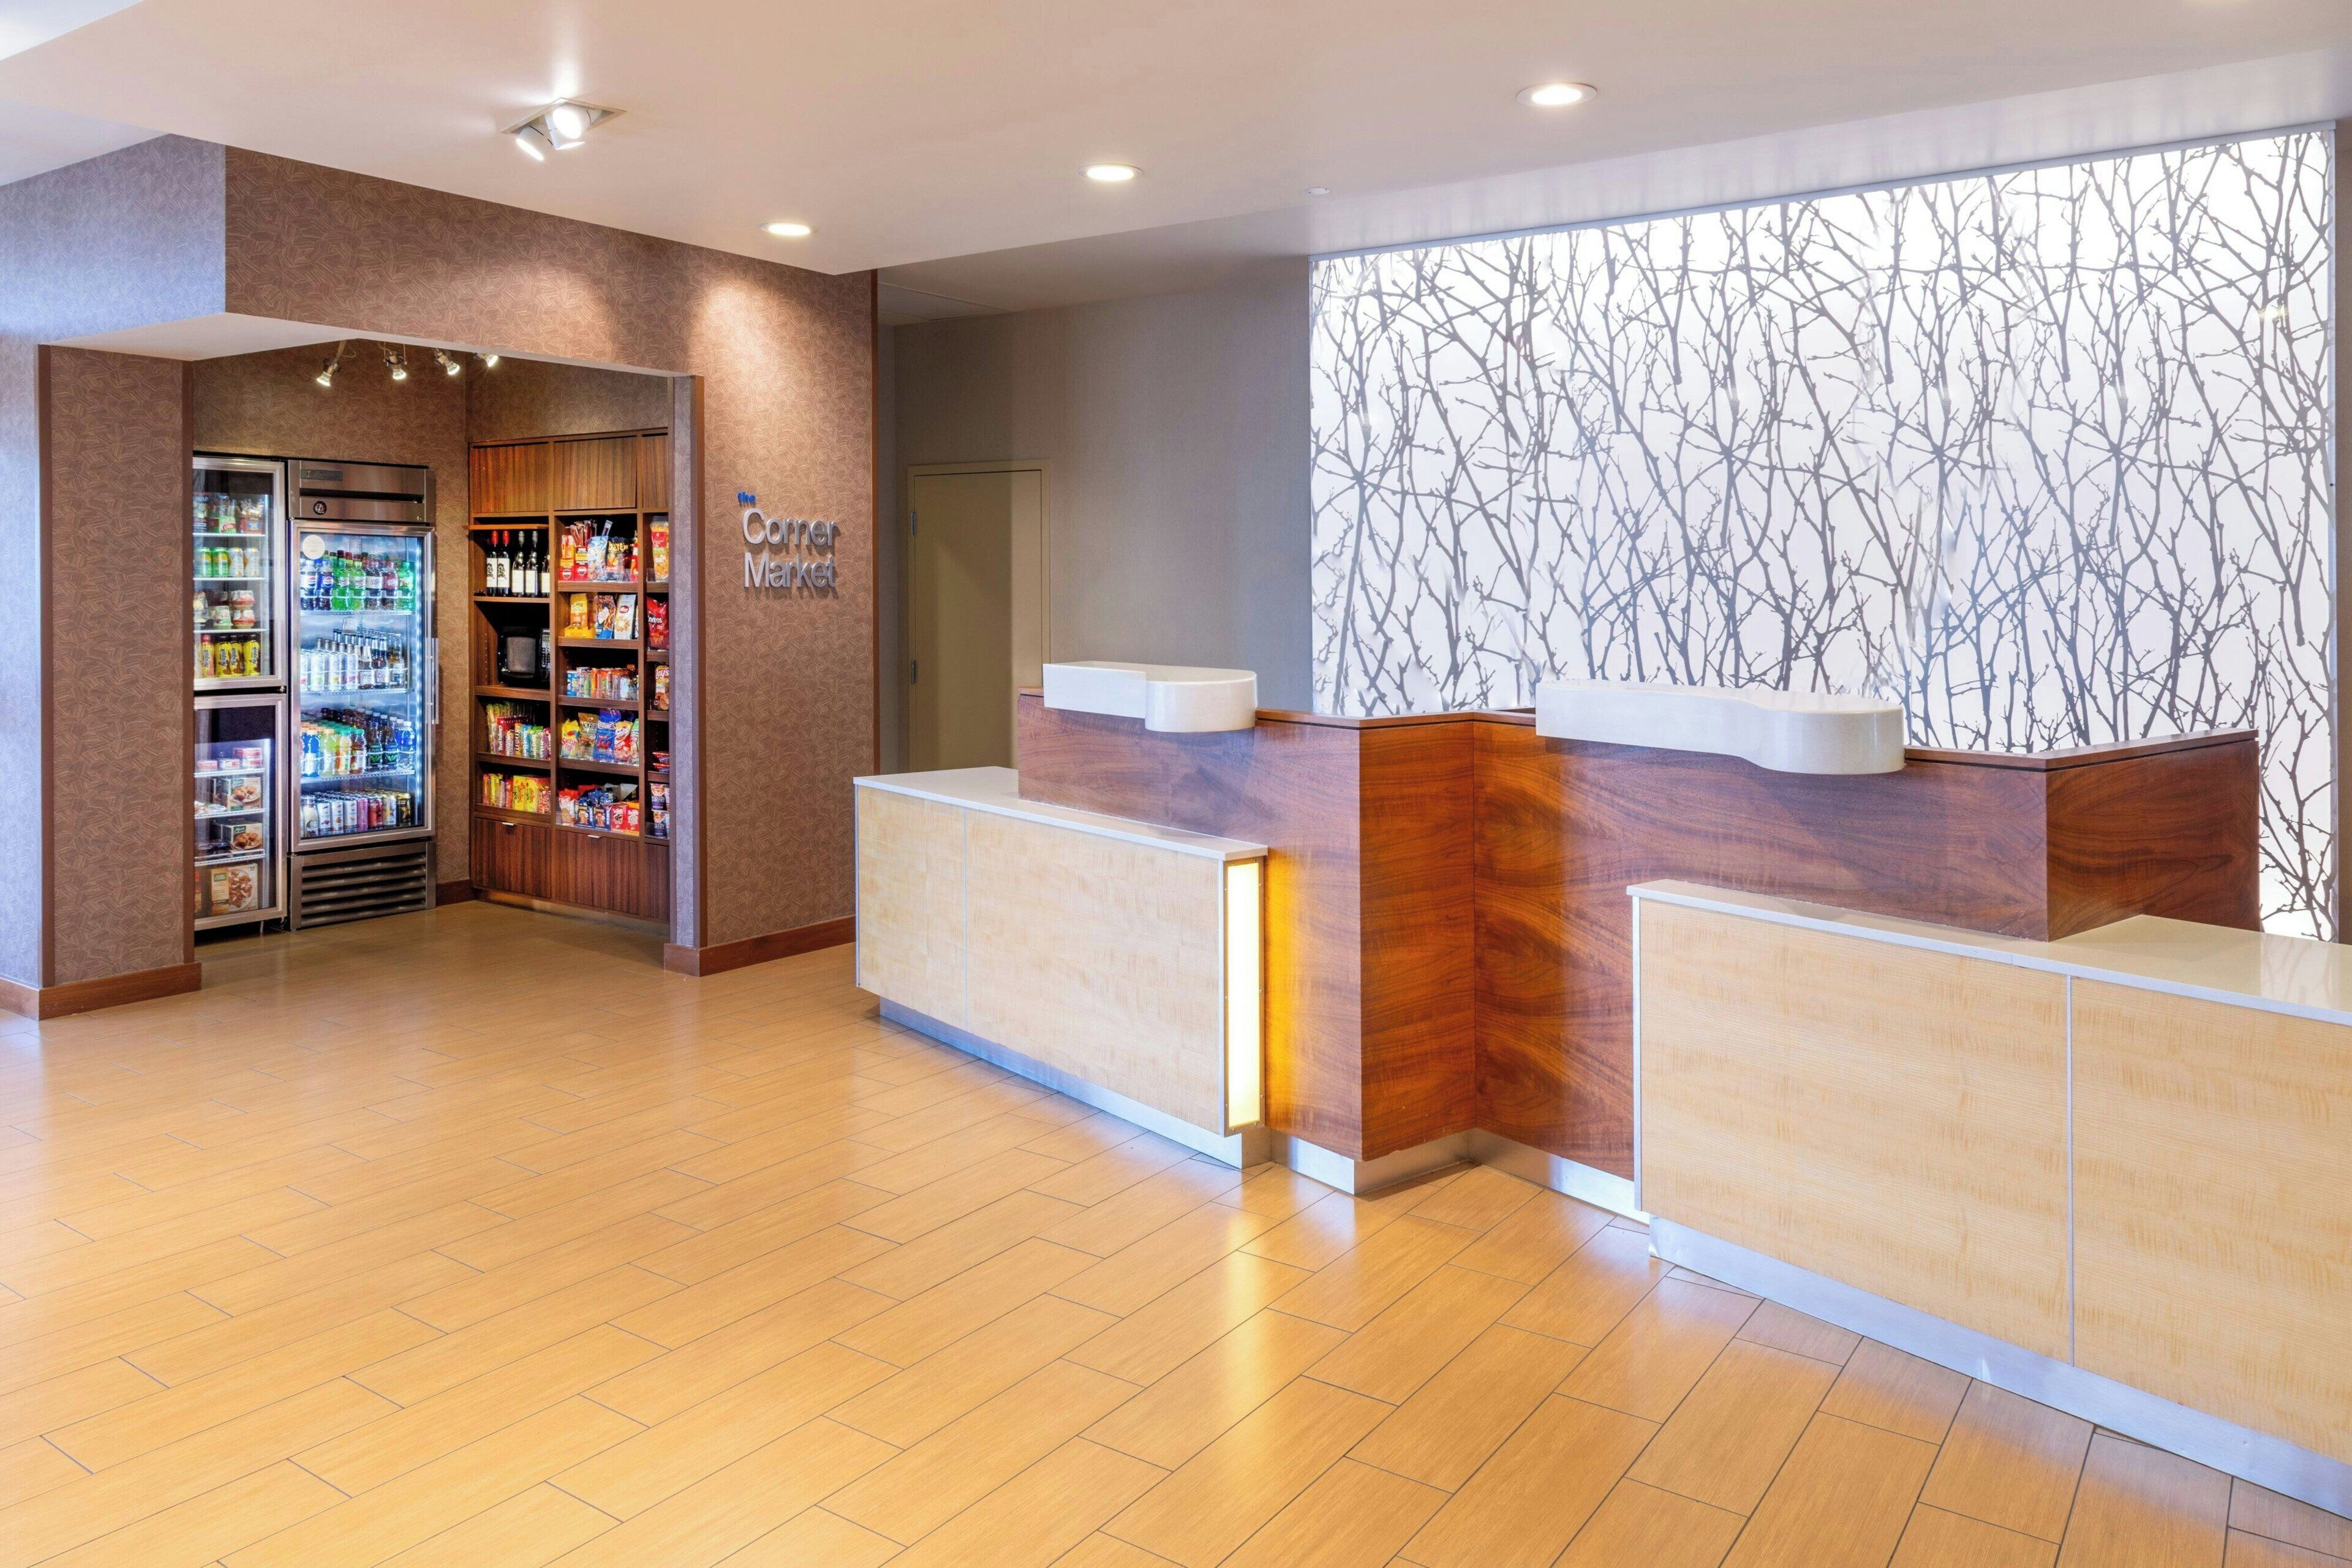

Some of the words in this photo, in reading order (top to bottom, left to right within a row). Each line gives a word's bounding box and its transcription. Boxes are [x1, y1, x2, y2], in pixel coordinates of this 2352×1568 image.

[737, 491, 756, 503] the
[743, 508, 837, 546] Corner
[744, 552, 835, 587] Market
